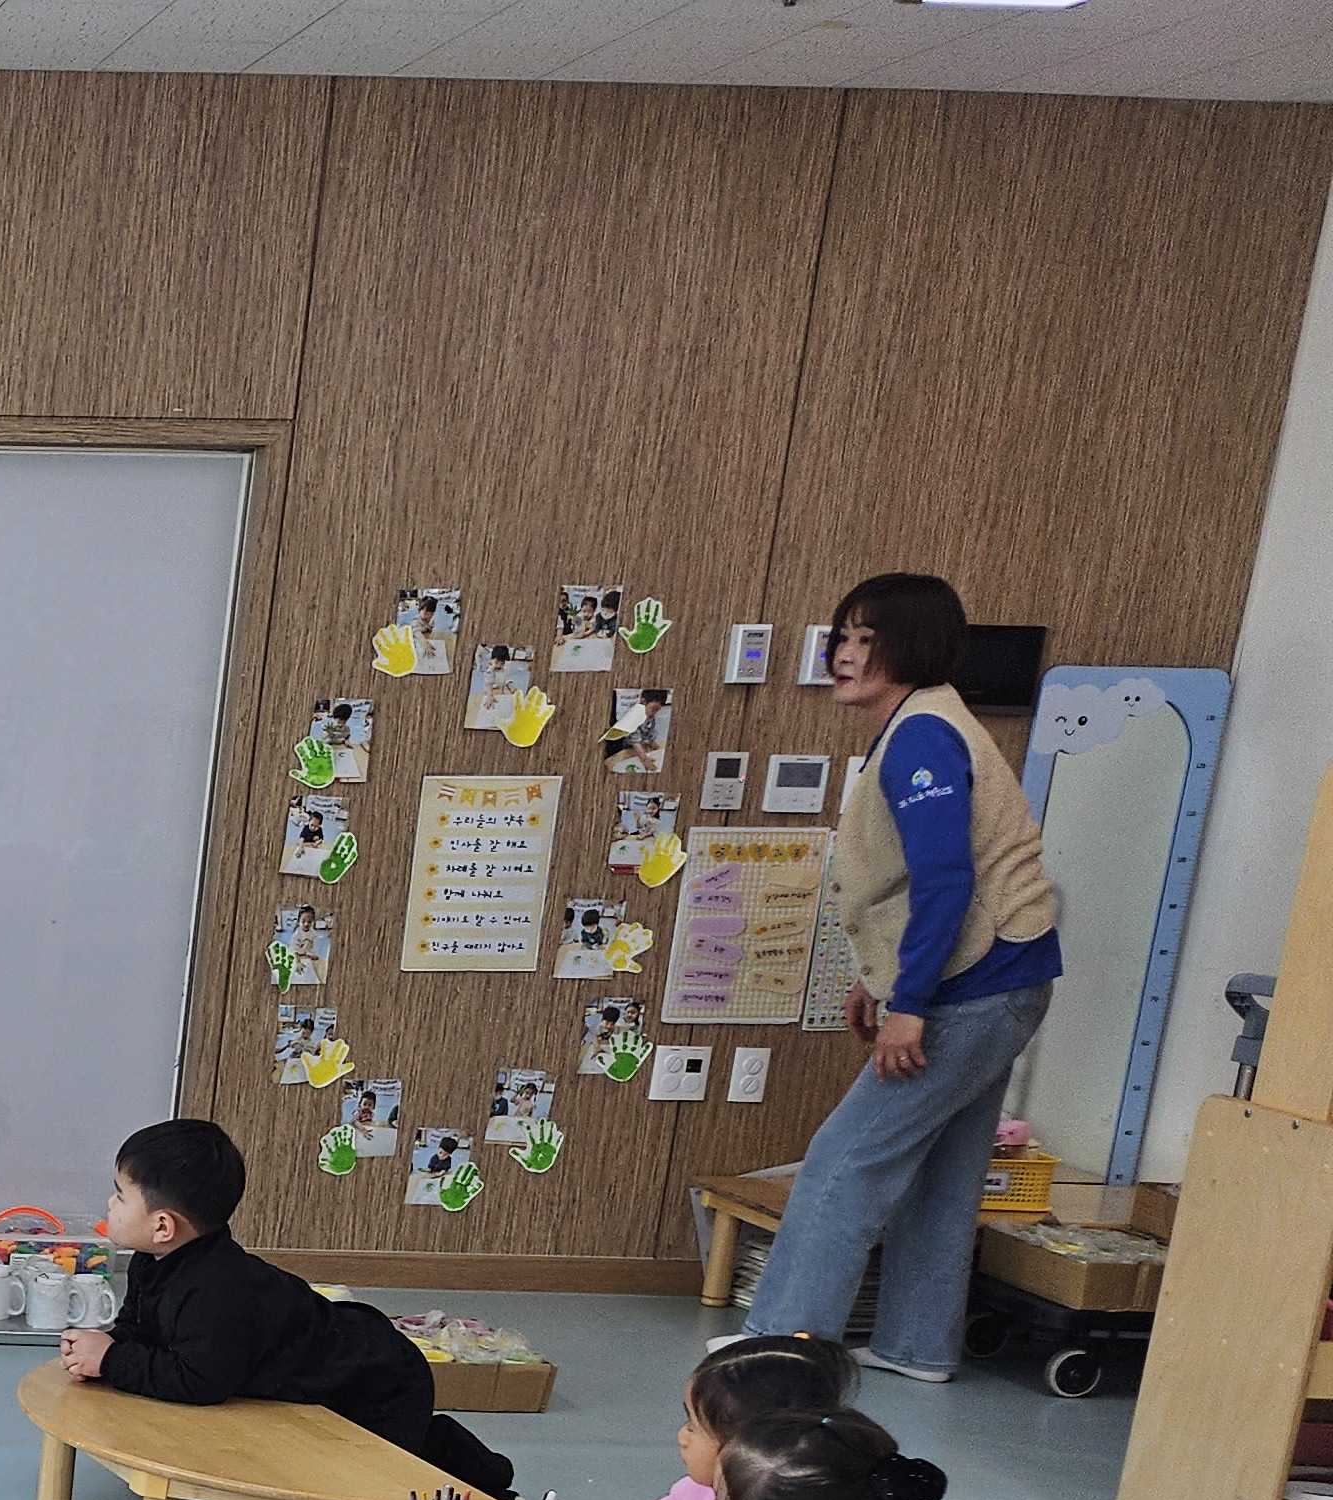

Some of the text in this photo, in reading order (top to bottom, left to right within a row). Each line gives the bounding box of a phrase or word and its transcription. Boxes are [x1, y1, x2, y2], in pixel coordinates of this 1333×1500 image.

[453, 813, 525, 829] 우리들의 약속
[450, 837, 528, 852] 인사를 잘 해요
[445, 862, 478, 878] 차례를
[485, 864, 496, 877] 잘
[443, 888, 466, 900] 함께
[489, 916, 498, 924] 수
[503, 915, 531, 925] 있어요
[431, 941, 459, 954] 친구를
[464, 942, 492, 950] 때리지
